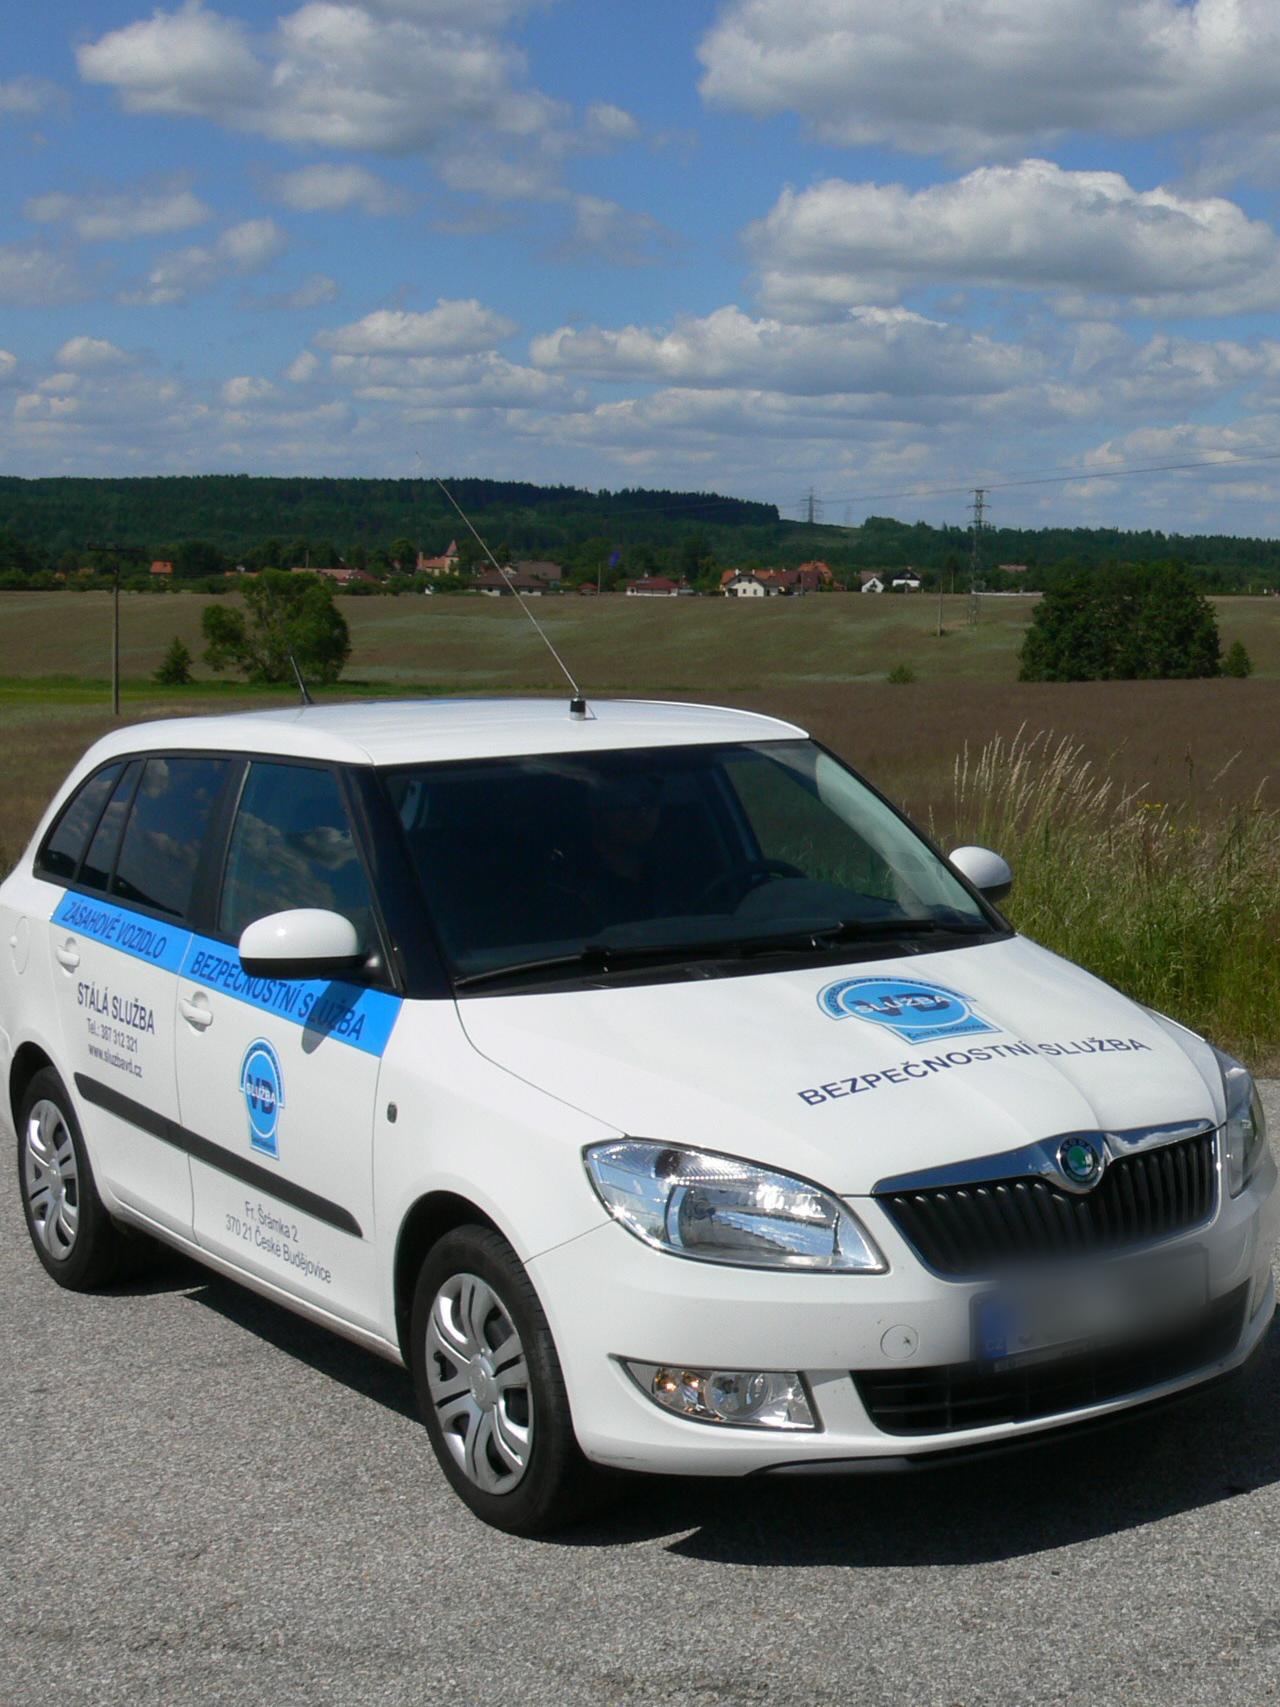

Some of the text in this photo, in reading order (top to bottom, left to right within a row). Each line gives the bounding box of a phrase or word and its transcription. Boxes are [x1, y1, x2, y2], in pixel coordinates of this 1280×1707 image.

[62, 900, 168, 959] ZÁSAHOVÉ VOZIDLO
[77, 981, 155, 1036] STÁLÁ SLUŽBA
[299, 992, 367, 1041] SLUŽBA
[797, 1037, 1152, 1106] BEZPEČNOSTNÍ SLUŽBA
[225, 1213, 332, 1284] 370 21 České Budějovice
[291, 1224, 299, 1243] 2
